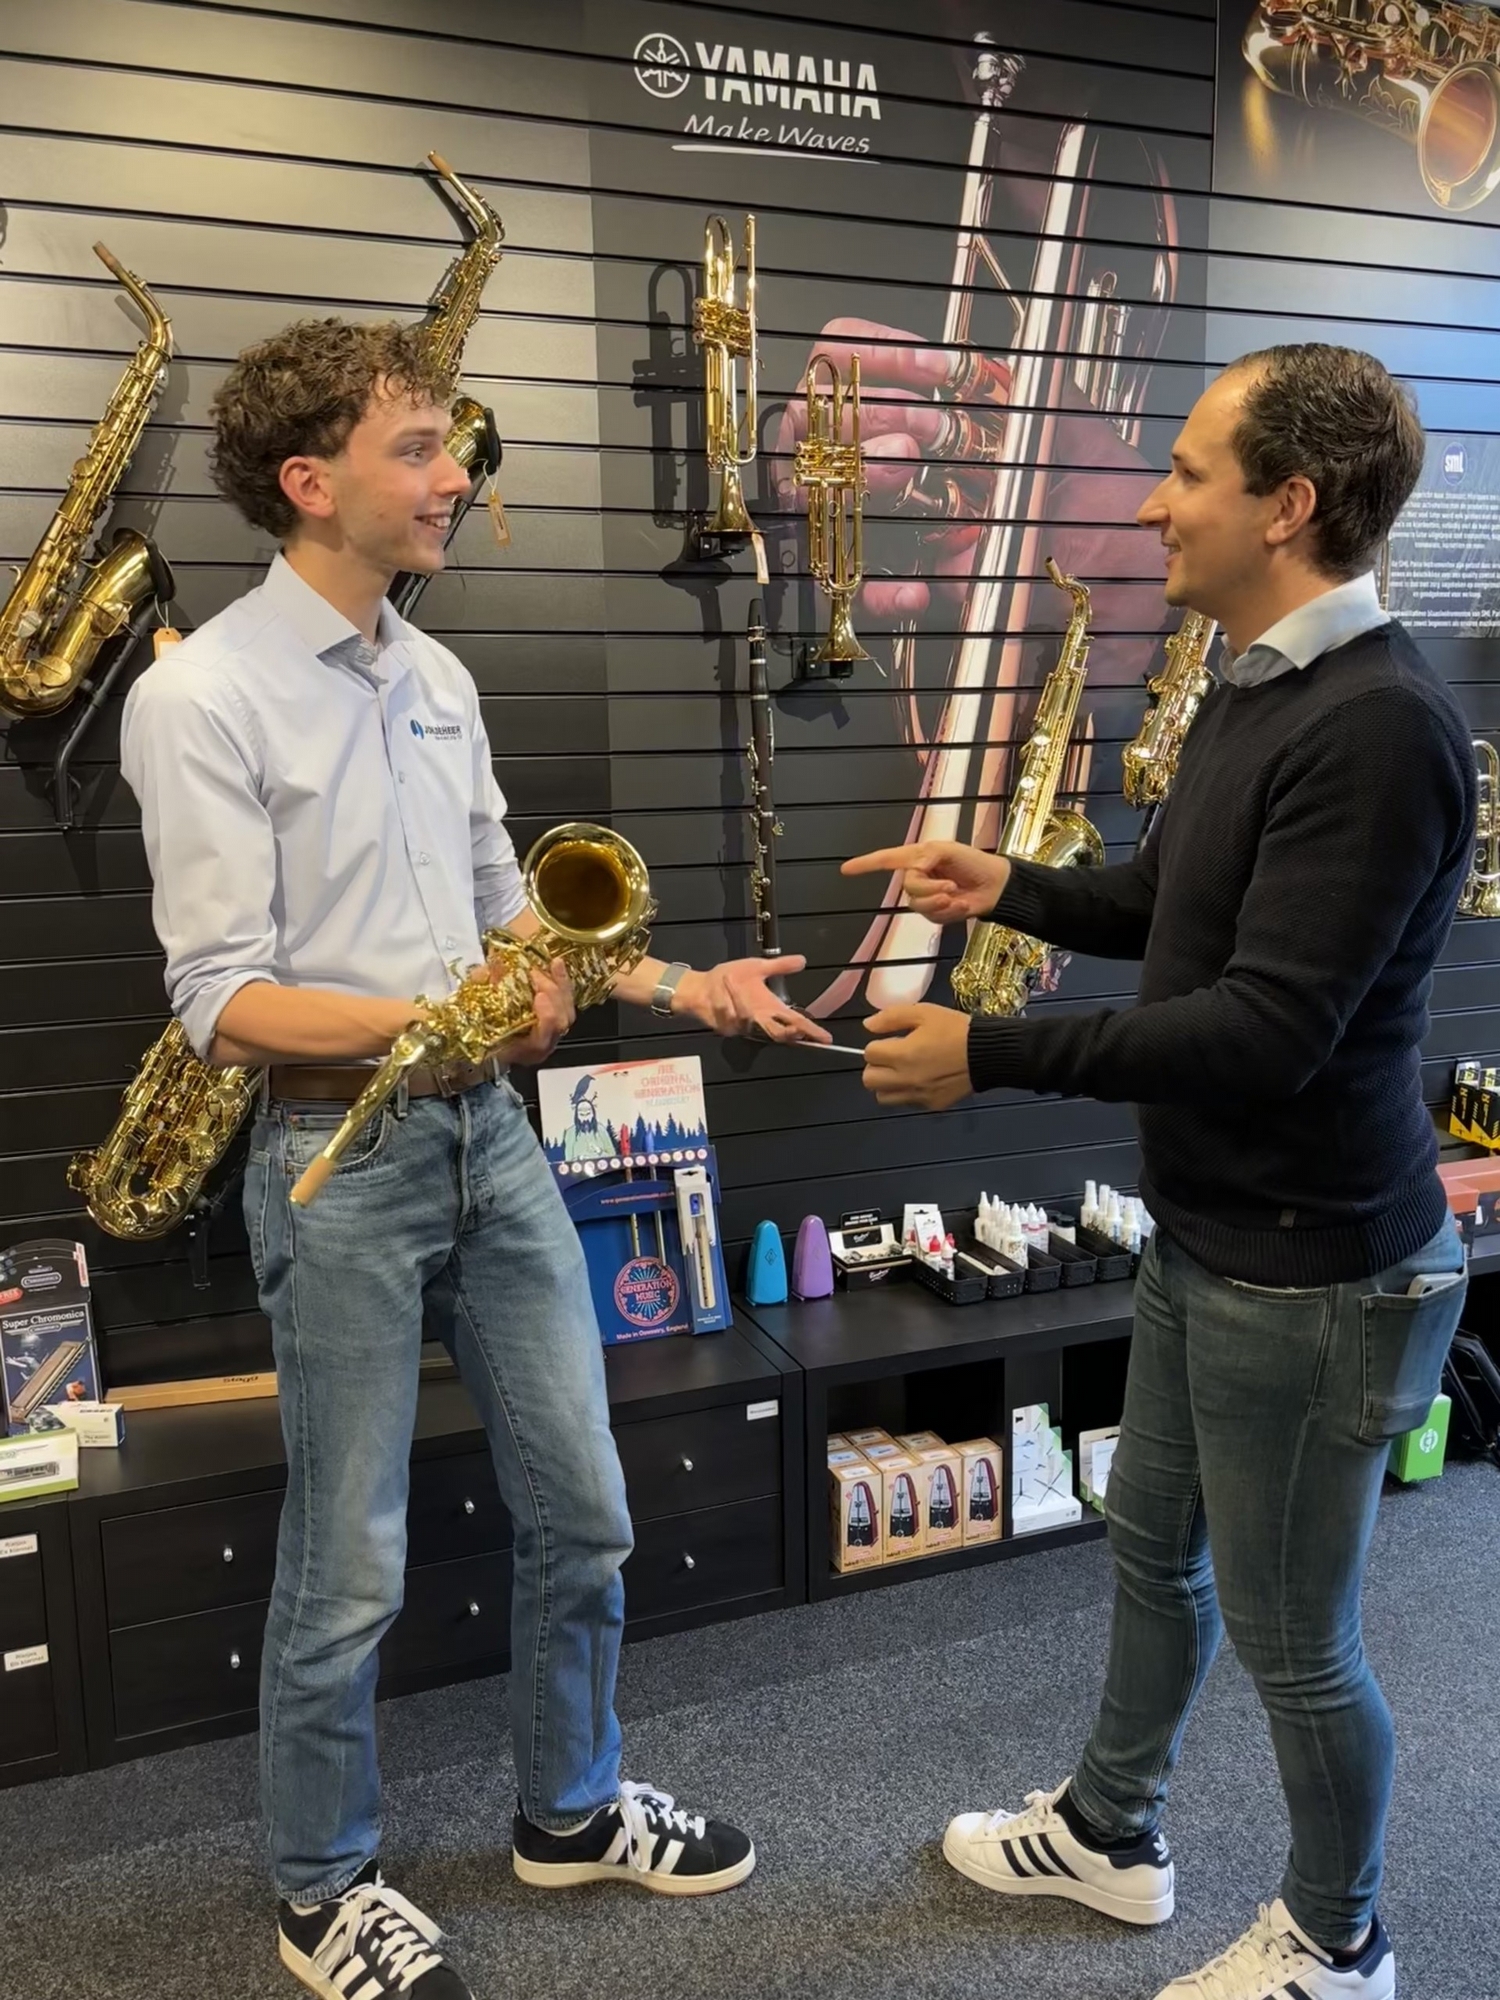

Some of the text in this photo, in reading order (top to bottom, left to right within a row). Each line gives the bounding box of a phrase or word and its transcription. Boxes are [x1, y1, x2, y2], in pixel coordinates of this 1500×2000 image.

[695, 42, 881, 120] YAMAHA
[684, 114, 871, 154] Make Waves
[620, 1277, 672, 1294] GENERATION
[635, 1290, 661, 1301] MUSIC
[2, 1319, 28, 1330] Super
[30, 1310, 85, 1324] Chromonica
